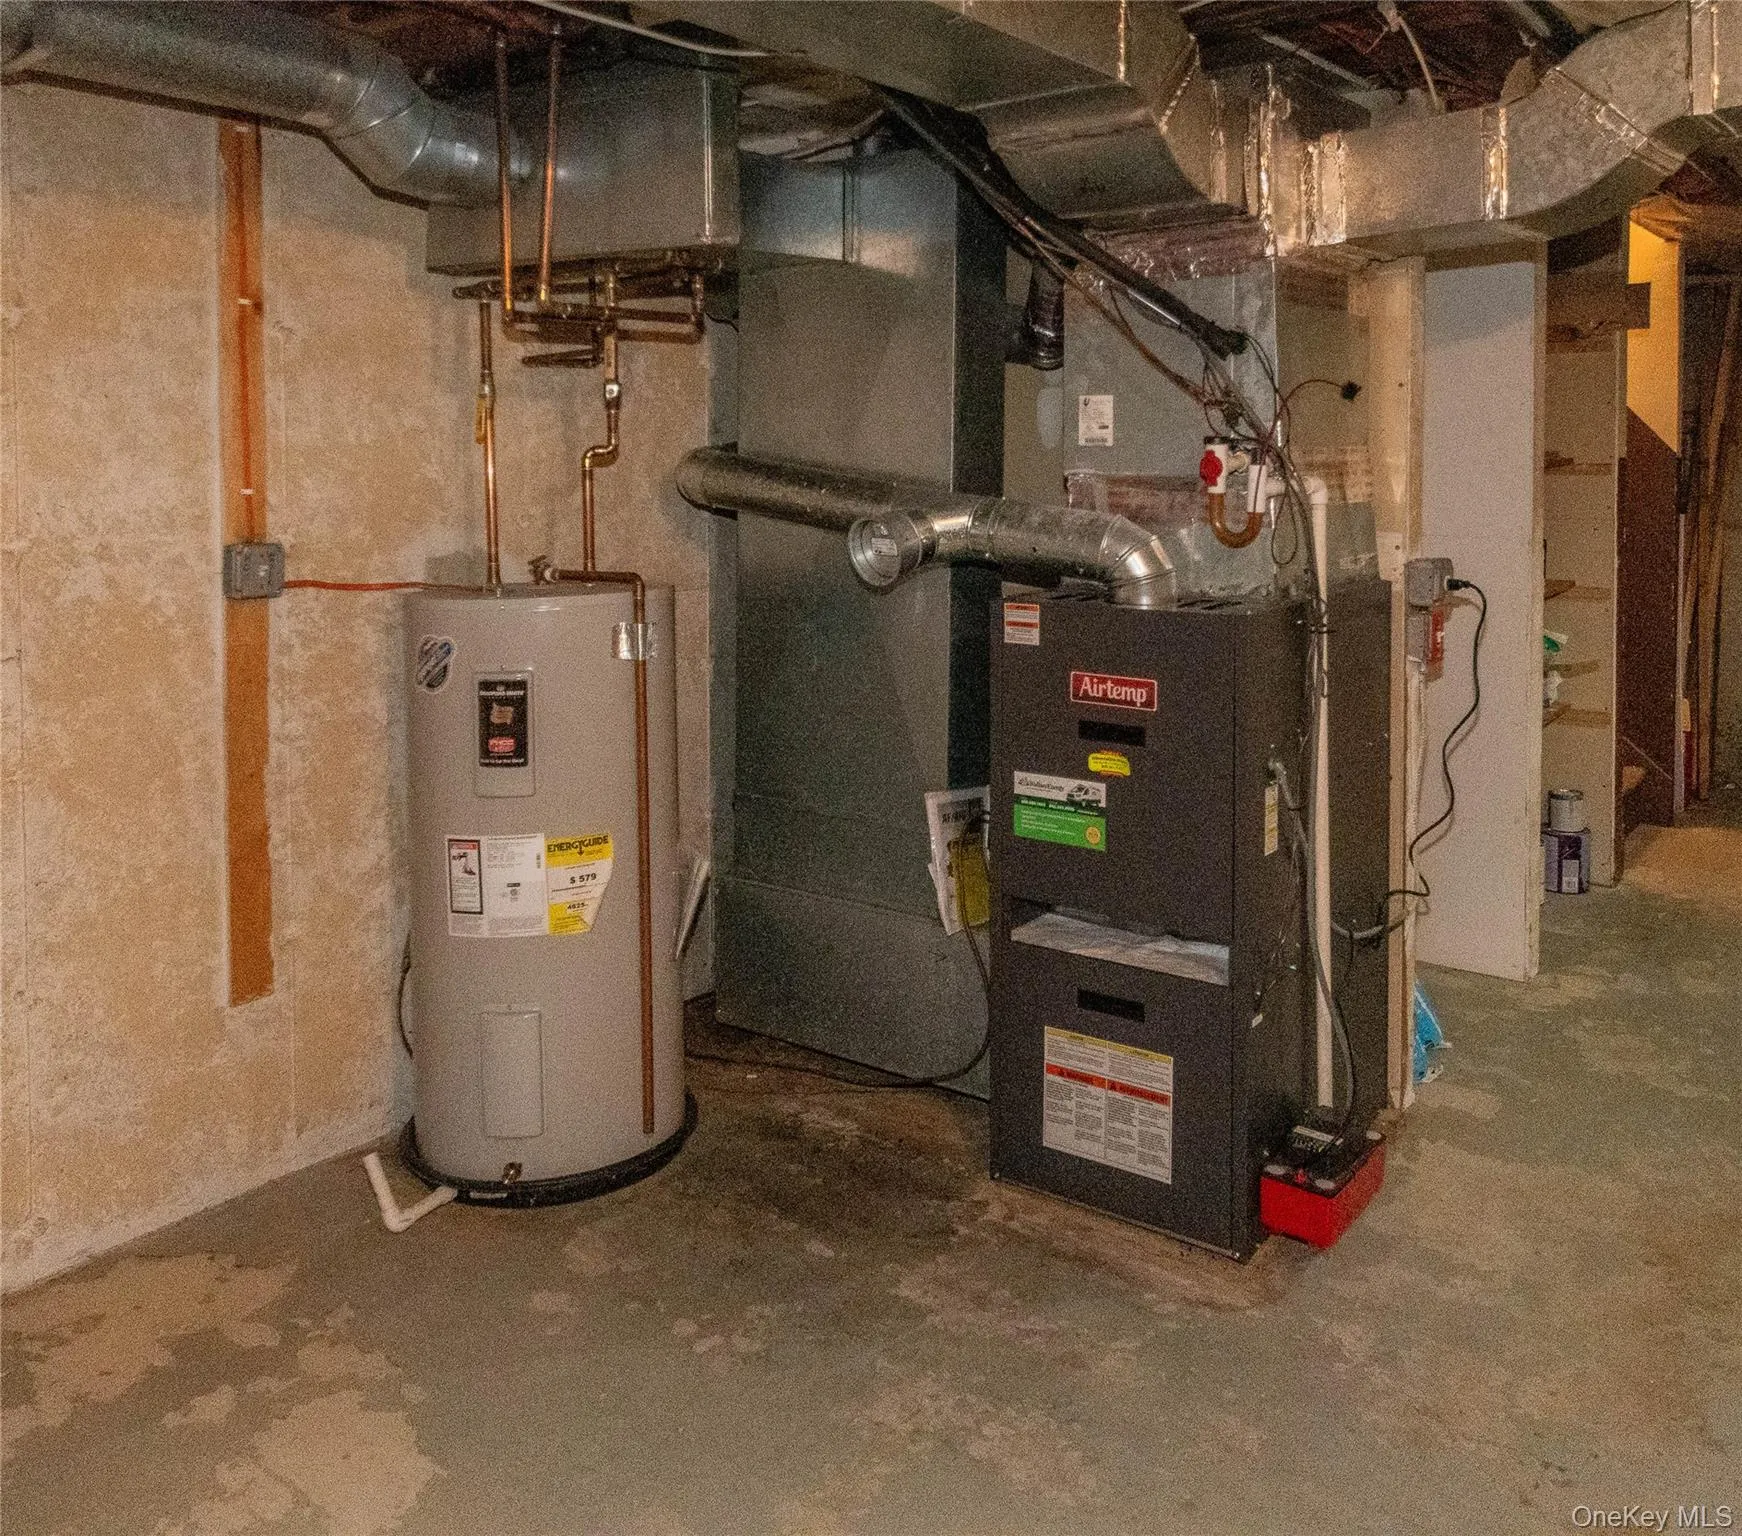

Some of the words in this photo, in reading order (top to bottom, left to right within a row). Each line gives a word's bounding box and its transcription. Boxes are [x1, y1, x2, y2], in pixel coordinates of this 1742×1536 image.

[1079, 676, 1147, 707] Airtemp
[569, 876, 576, 884] $
[579, 872, 597, 883] 579
